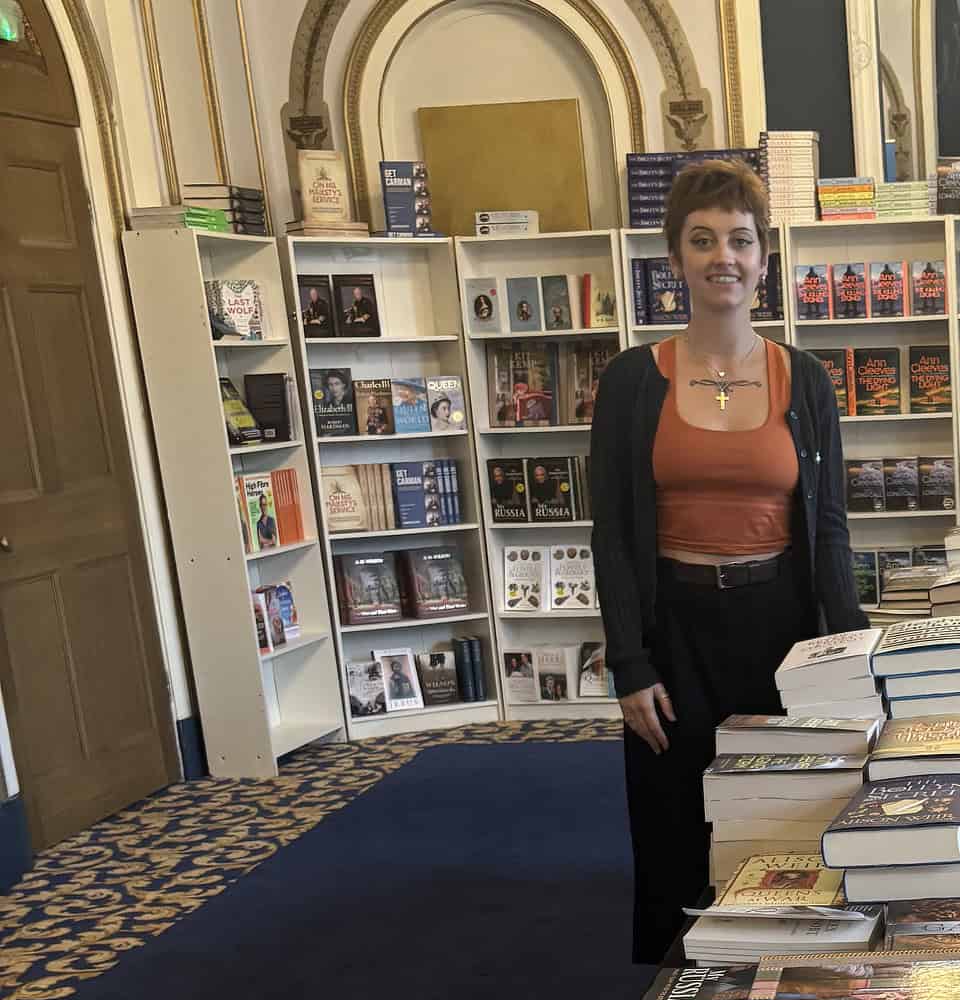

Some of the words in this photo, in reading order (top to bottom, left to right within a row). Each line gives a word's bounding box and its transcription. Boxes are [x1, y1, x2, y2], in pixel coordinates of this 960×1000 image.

[867, 358, 886, 367] Ann
[920, 356, 940, 364] Ann
[858, 367, 896, 375] Cleeves
[911, 364, 949, 373] Cleeves
[495, 508, 526, 517] RUSSIA
[536, 508, 570, 517] RUSSIA
